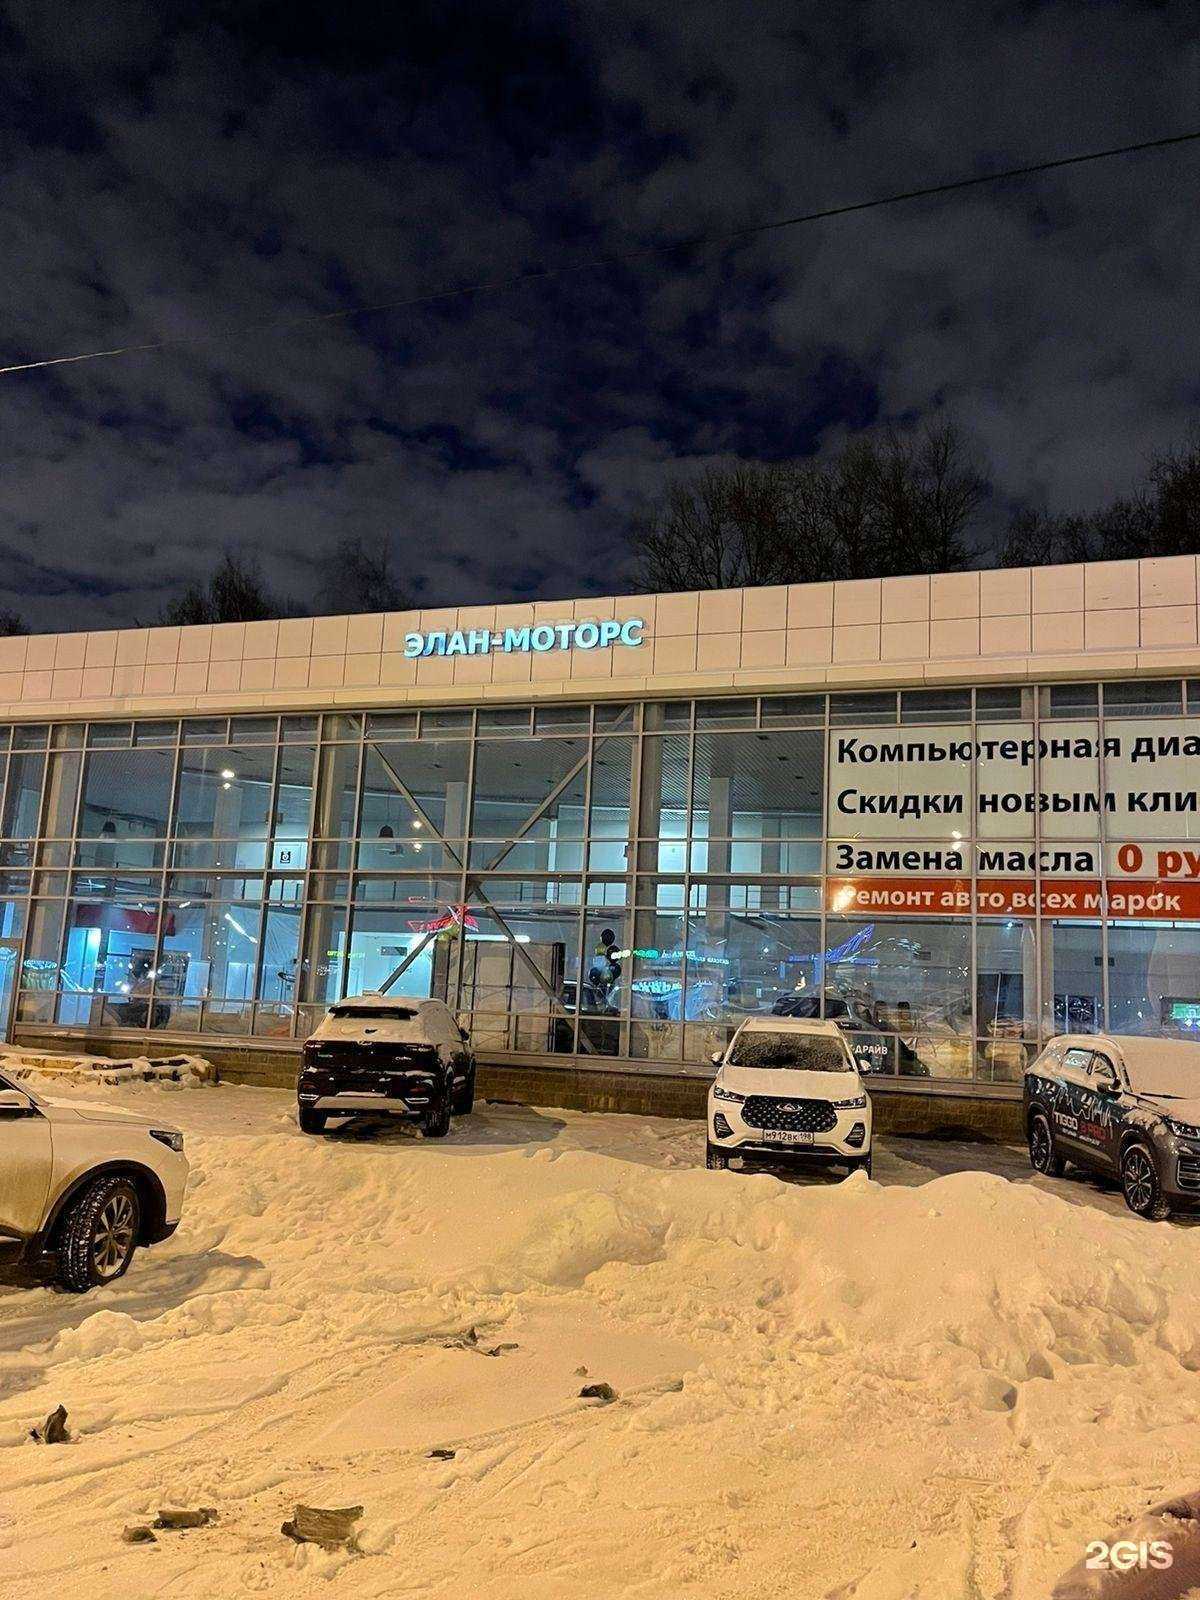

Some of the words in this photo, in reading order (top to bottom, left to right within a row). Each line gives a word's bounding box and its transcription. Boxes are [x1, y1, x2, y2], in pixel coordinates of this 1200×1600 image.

[403, 620, 643, 658] ЭЛАН-МОТОРС
[838, 735, 1121, 766] Компьютерная
[837, 789, 963, 818] Скидки
[979, 791, 1116, 813] новым
[836, 844, 963, 871] Замена
[979, 849, 1094, 872] масла
[1118, 843, 1143, 873] 0
[941, 893, 1005, 909] авто
[1012, 893, 1076, 910] всех
[1083, 893, 1181, 916] марок
